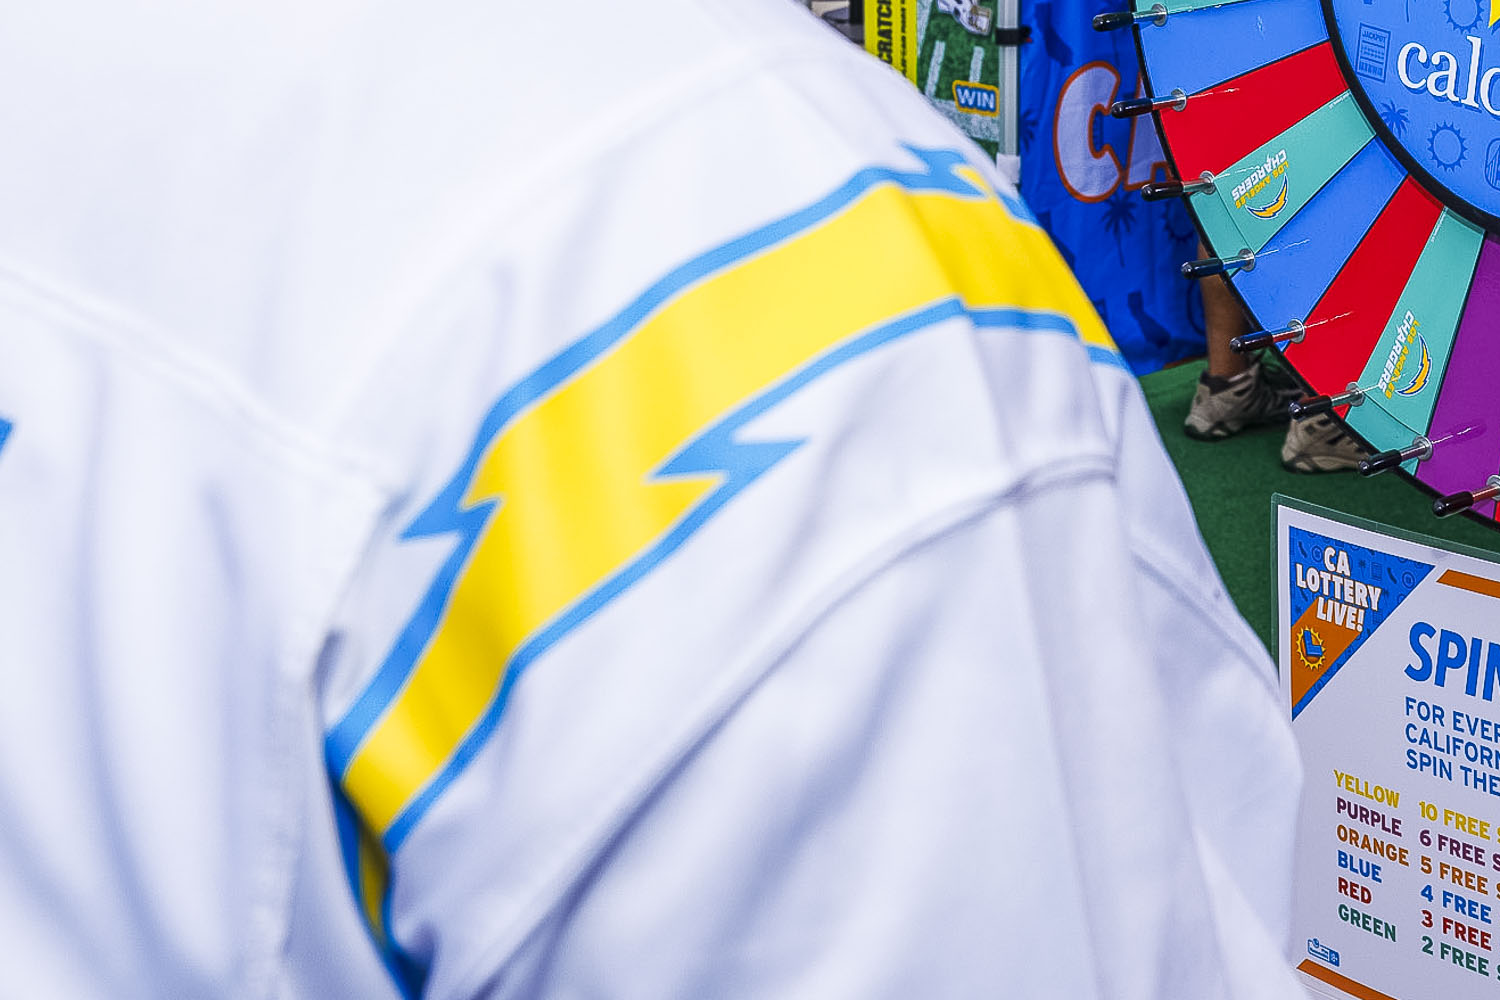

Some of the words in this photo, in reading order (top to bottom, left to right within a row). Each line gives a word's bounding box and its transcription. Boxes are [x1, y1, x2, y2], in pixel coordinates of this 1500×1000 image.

[1362, 30, 1388, 43] JACKPOT
[956, 87, 996, 110] WIN
[1231, 149, 1287, 201] CHARGERS
[1378, 310, 1415, 393] CHARGERS
[1296, 563, 1382, 612] LOTTERY
[1323, 546, 1351, 577] CA
[1316, 596, 1366, 633] LIVE!
[1405, 696, 1445, 727] FOR
[1406, 749, 1452, 781] SPIN
[1460, 765, 1500, 797] THE
[1333, 769, 1400, 809] YELLOW
[1418, 801, 1438, 821] 10
[1443, 809, 1490, 841] FREE
[1336, 797, 1402, 837] PURPLE
[1419, 829, 1432, 847] 6
[1437, 833, 1486, 866] FREE
[1336, 824, 1409, 867] ORANGE
[1420, 855, 1433, 875] 5
[1439, 862, 1489, 896] FREE
[1337, 850, 1382, 883] BLUE
[1420, 884, 1433, 902] 4
[1442, 890, 1492, 925] FREE
[1337, 876, 1372, 904] RED
[1421, 909, 1434, 928] 3
[1442, 918, 1492, 952] FREE
[1338, 904, 1397, 943] GREEN
[1421, 936, 1434, 955] 2
[1441, 942, 1490, 977] FREE
